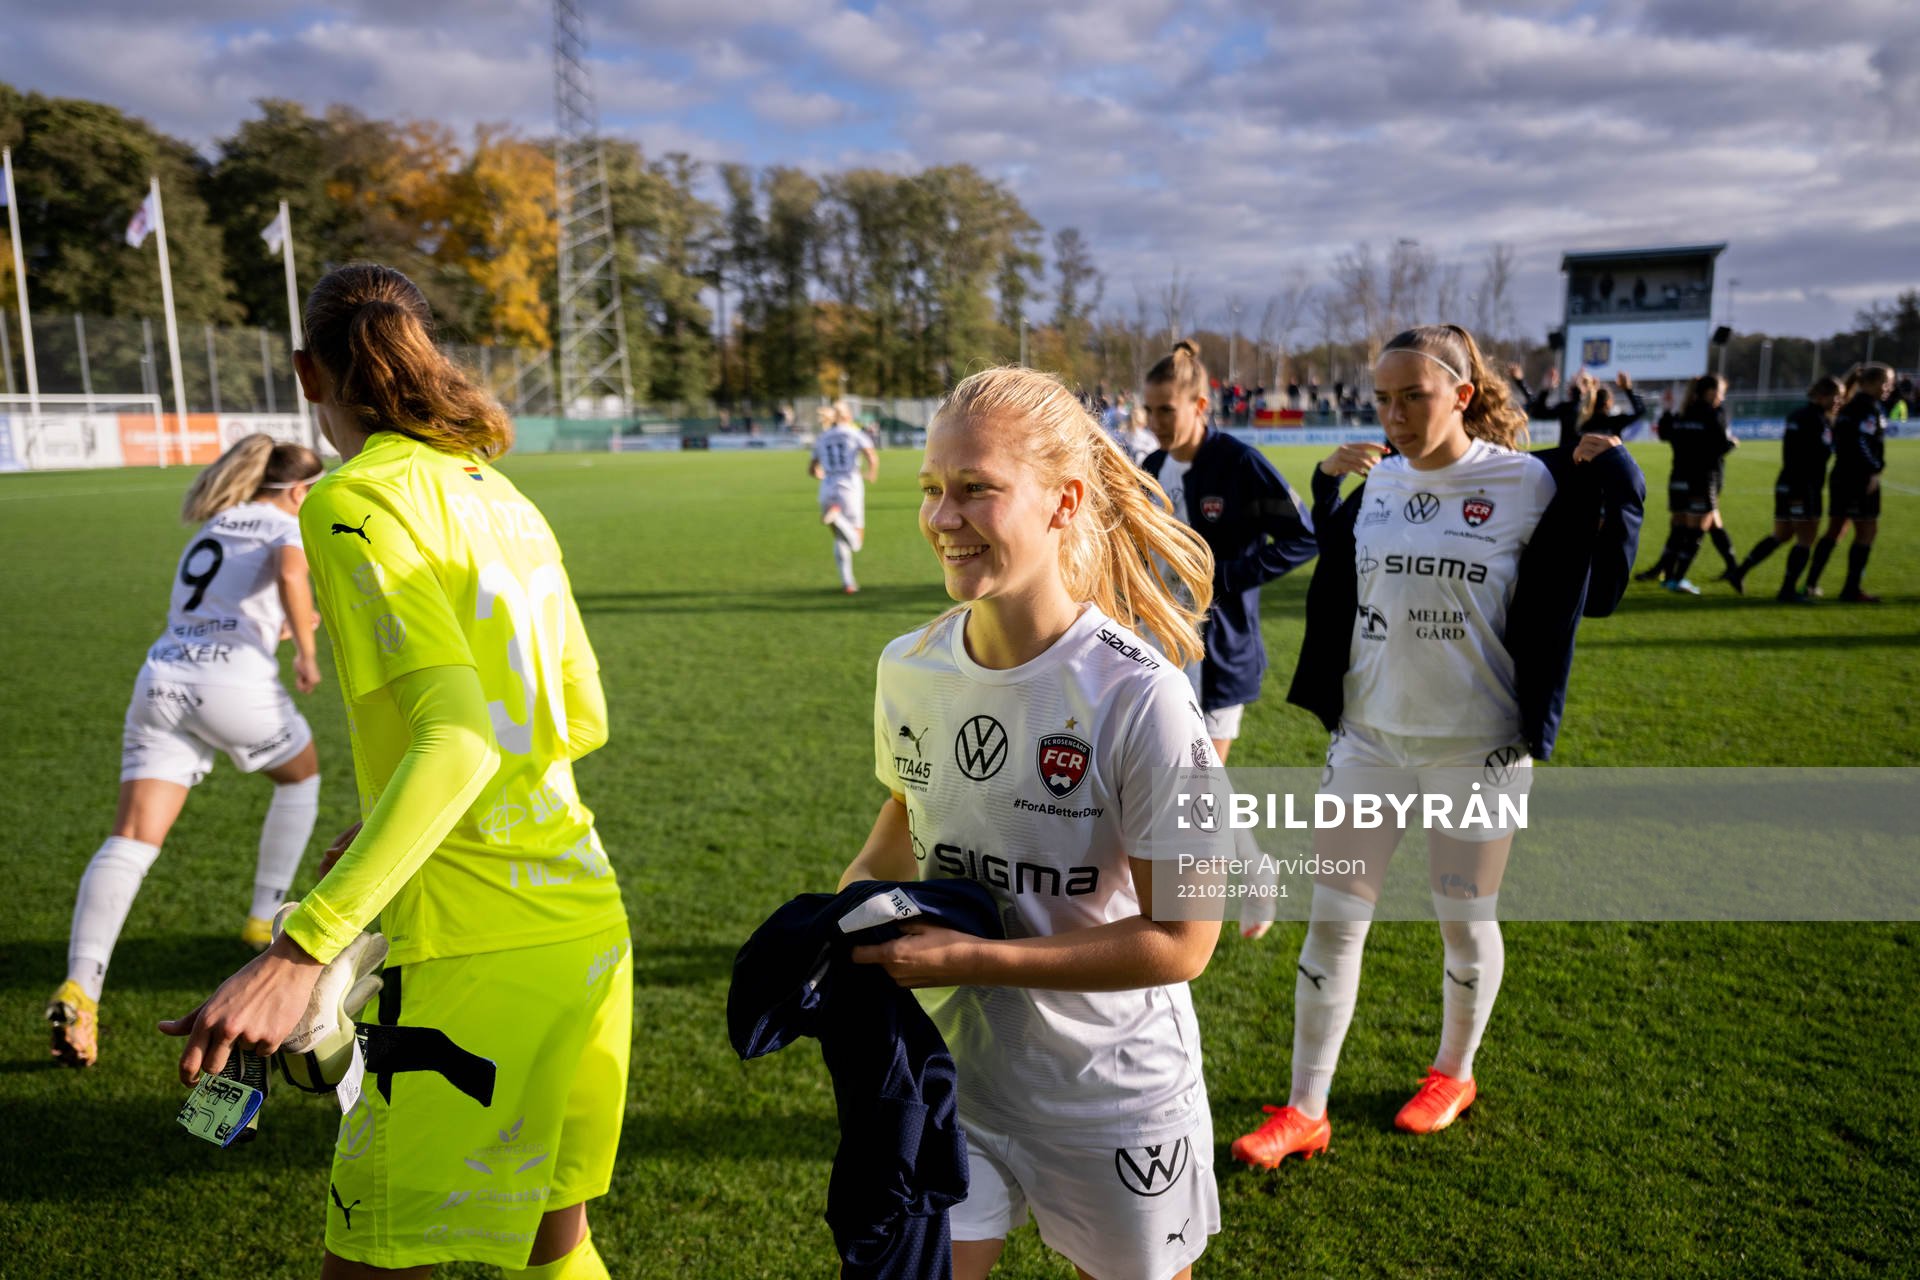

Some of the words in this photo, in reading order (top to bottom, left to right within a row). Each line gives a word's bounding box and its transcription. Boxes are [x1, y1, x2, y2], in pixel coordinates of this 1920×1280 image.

[1465, 503, 1490, 516] FCR
[181, 538, 224, 613] 9
[1408, 608, 1471, 625] MELLBY
[1416, 624, 1465, 641] GÅRD
[1095, 627, 1161, 672] stadium
[892, 753, 933, 779] TTA45
[1043, 749, 1084, 770] FCR
[1014, 798, 1105, 819] #ForABetterDay
